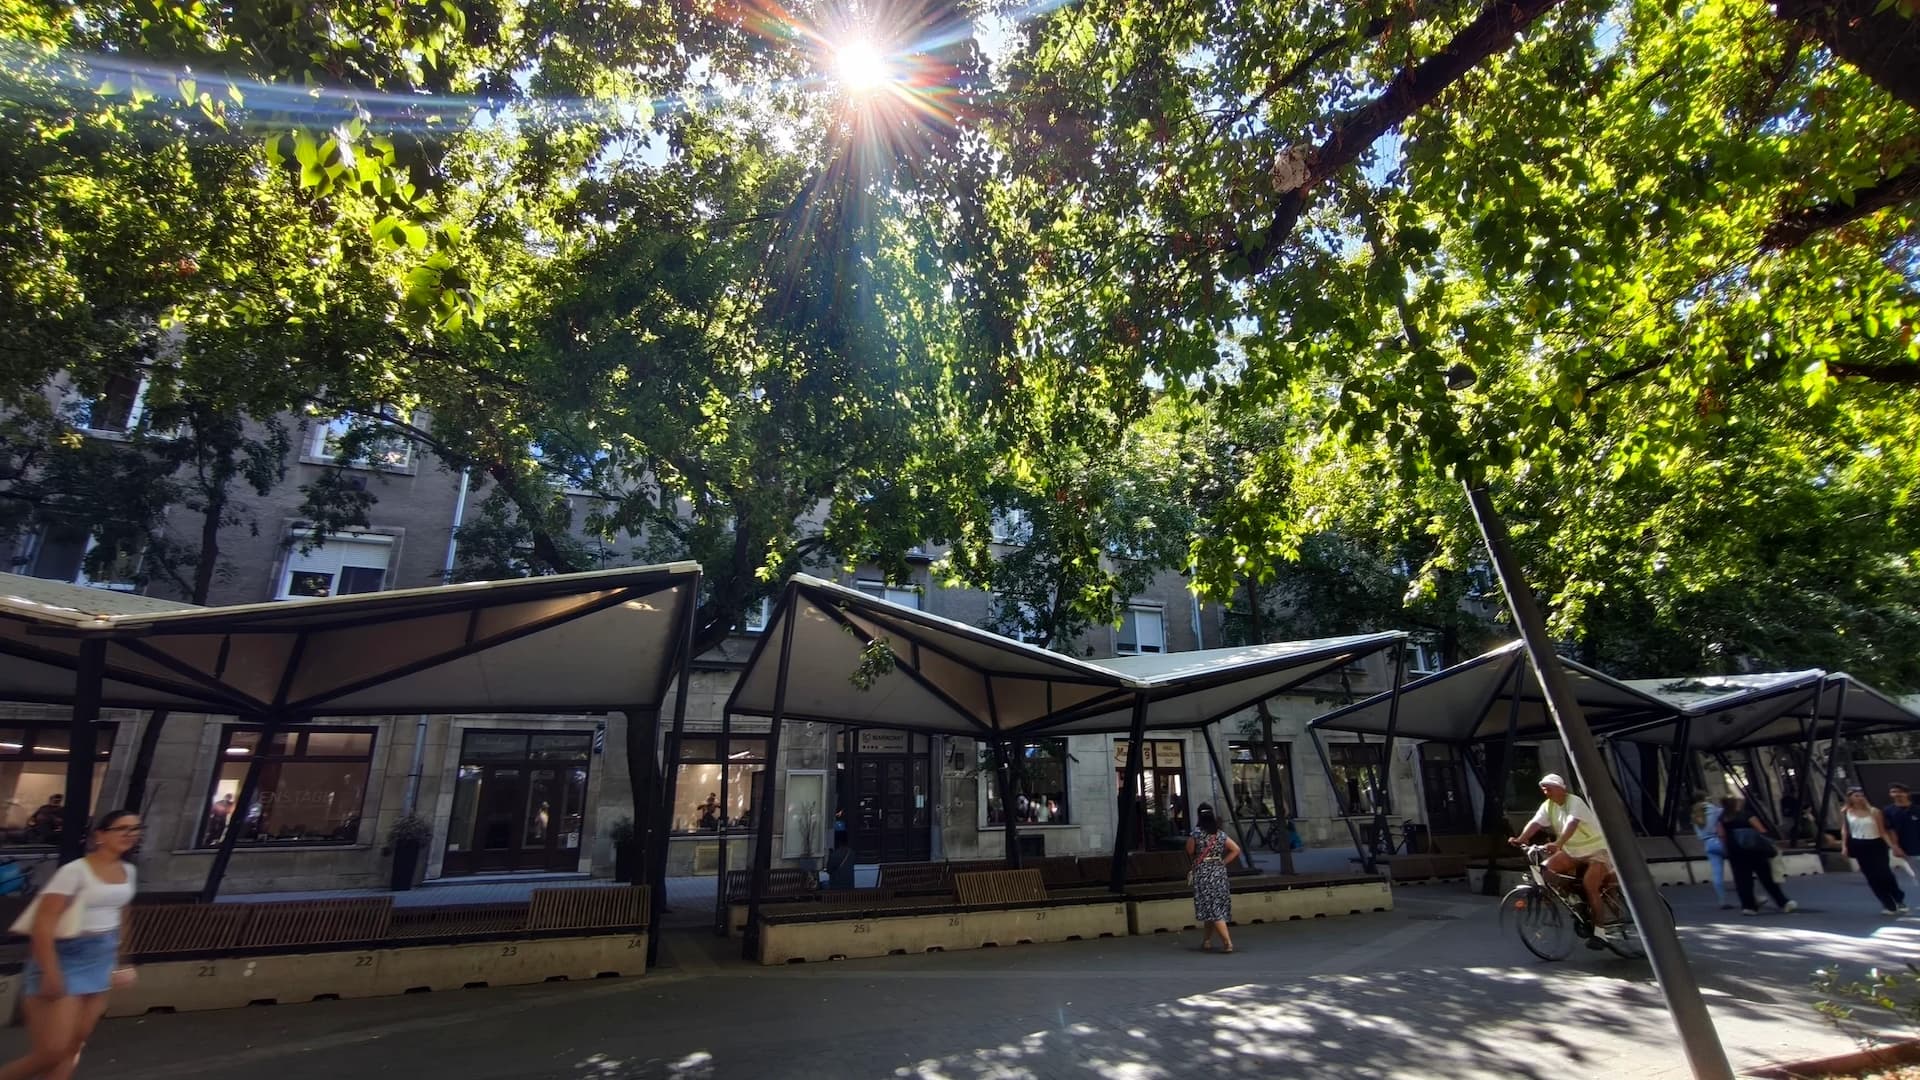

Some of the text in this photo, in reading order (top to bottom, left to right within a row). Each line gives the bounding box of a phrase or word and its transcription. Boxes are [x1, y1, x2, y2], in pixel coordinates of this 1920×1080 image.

[948, 917, 960, 927] 26
[1035, 912, 1047, 922] 27
[627, 938, 641, 950] 24
[501, 945, 518, 957] 23
[354, 956, 373, 968] 22
[197, 966, 216, 978] 21
